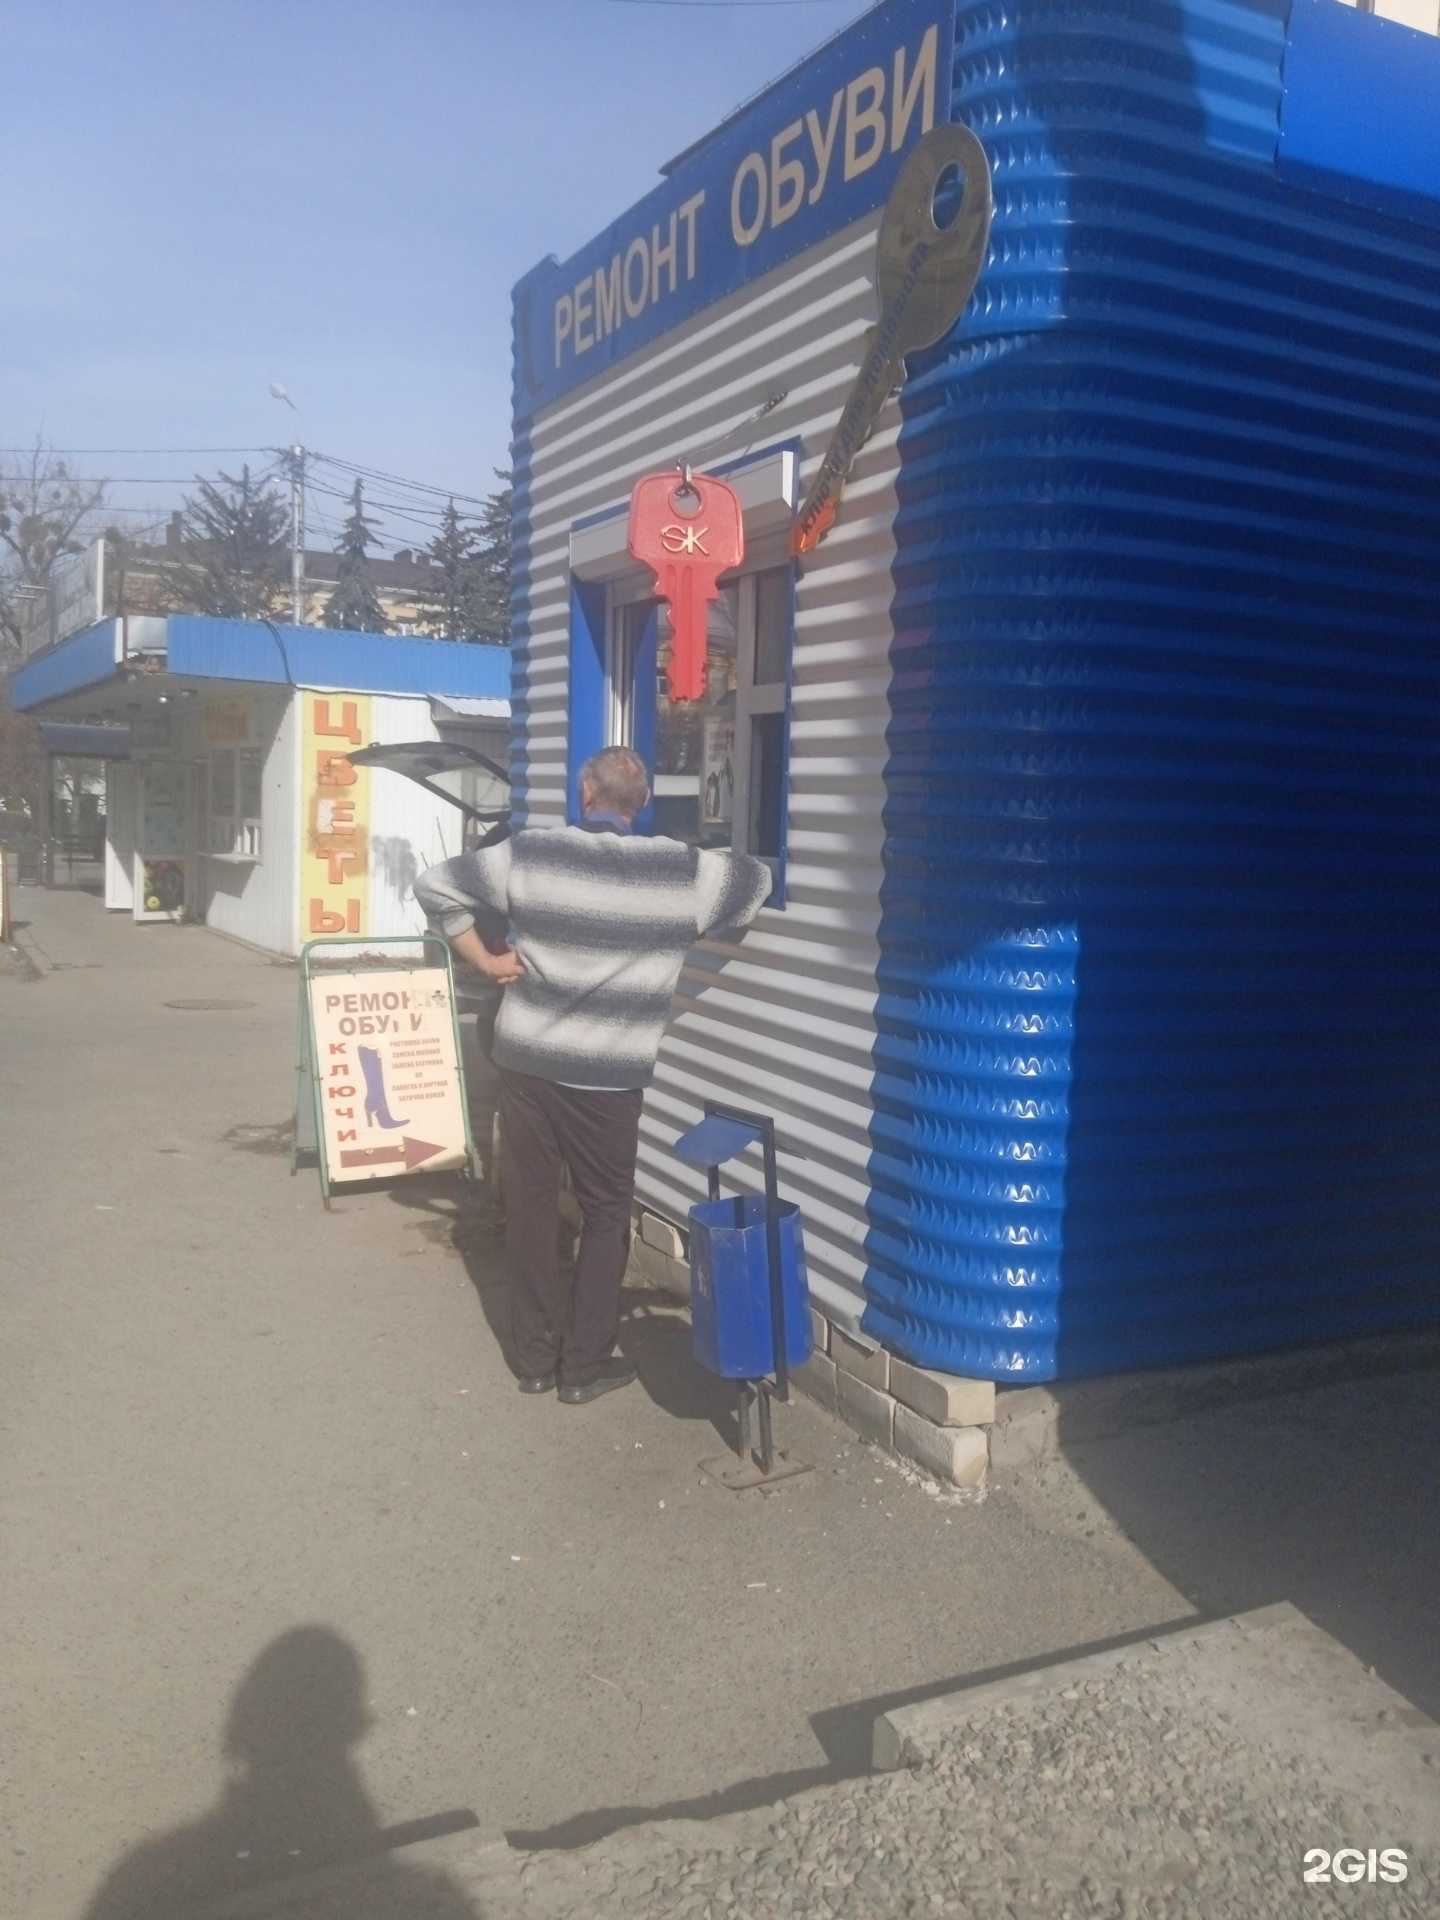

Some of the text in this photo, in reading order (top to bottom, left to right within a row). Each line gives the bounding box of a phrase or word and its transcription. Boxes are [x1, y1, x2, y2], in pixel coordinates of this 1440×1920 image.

[554, 23, 938, 369] РЕМОНТ ОБУВИ
[309, 700, 362, 934] ЦВЕТЫ
[328, 1042, 357, 1142] КЛЮЧИ
[338, 1012, 423, 1036] ОБУИ
